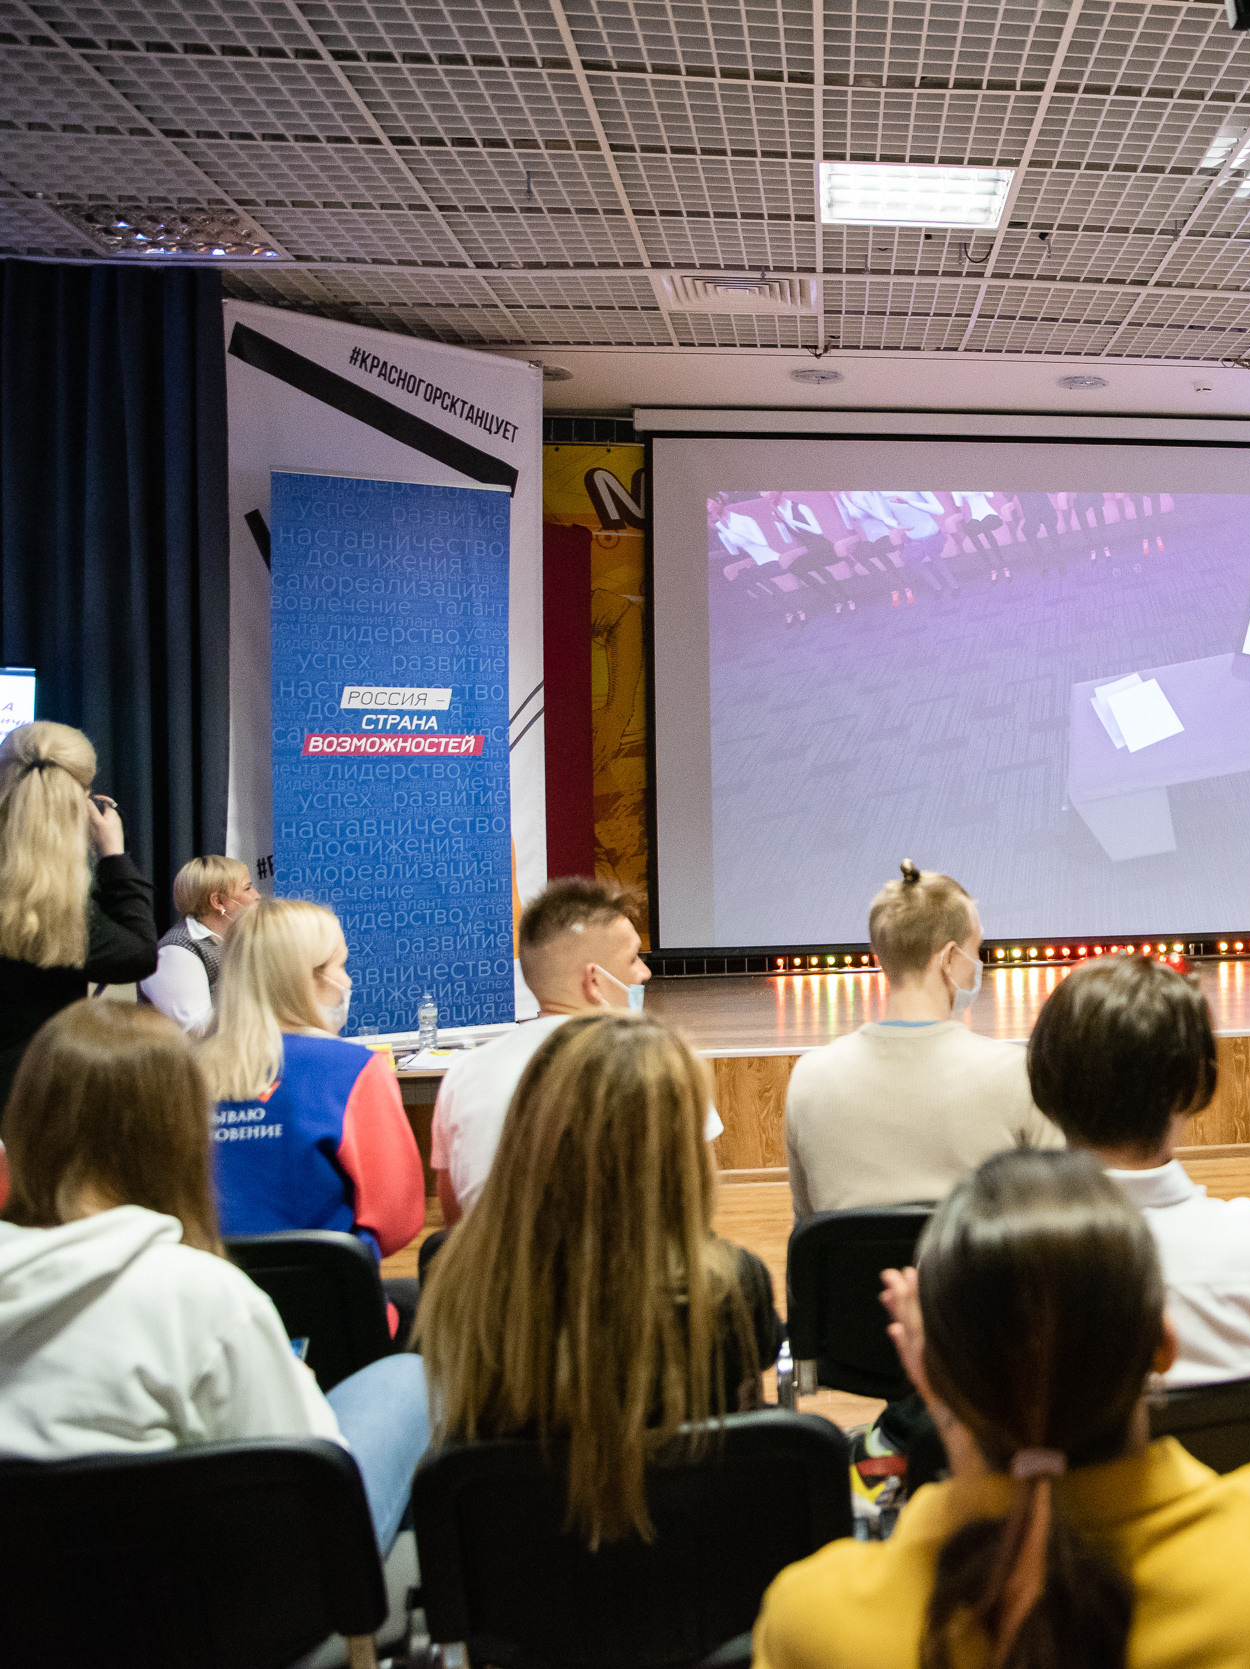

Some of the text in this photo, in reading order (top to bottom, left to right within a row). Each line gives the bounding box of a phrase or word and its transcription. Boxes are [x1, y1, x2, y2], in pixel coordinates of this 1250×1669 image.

[349, 346, 519, 443] #КРАСНОГОРСКТАНЦУЕТ
[298, 500, 371, 521] успех
[392, 505, 506, 531] развитие
[279, 526, 504, 558] наставничество
[306, 549, 462, 573] достижения
[271, 573, 490, 600] самореализация
[270, 595, 504, 616] вовлечение талант
[326, 624, 461, 647] лидерство
[298, 652, 506, 676] успех развитие
[347, 690, 428, 706] РОССИЯ
[361, 714, 438, 730] СТРАНА
[308, 735, 476, 753] ВОЗМОЖНОСТЕЙ
[327, 762, 461, 784] лидерство
[299, 790, 507, 814] успех развитие
[281, 816, 506, 840] наставничество
[308, 836, 465, 861] достижения
[273, 860, 494, 887] самореализация
[440, 879, 508, 895] талант
[395, 932, 510, 960] развитие
[350, 959, 509, 986] авничество
[212, 1124, 283, 1141] ОВЕНИЕ
